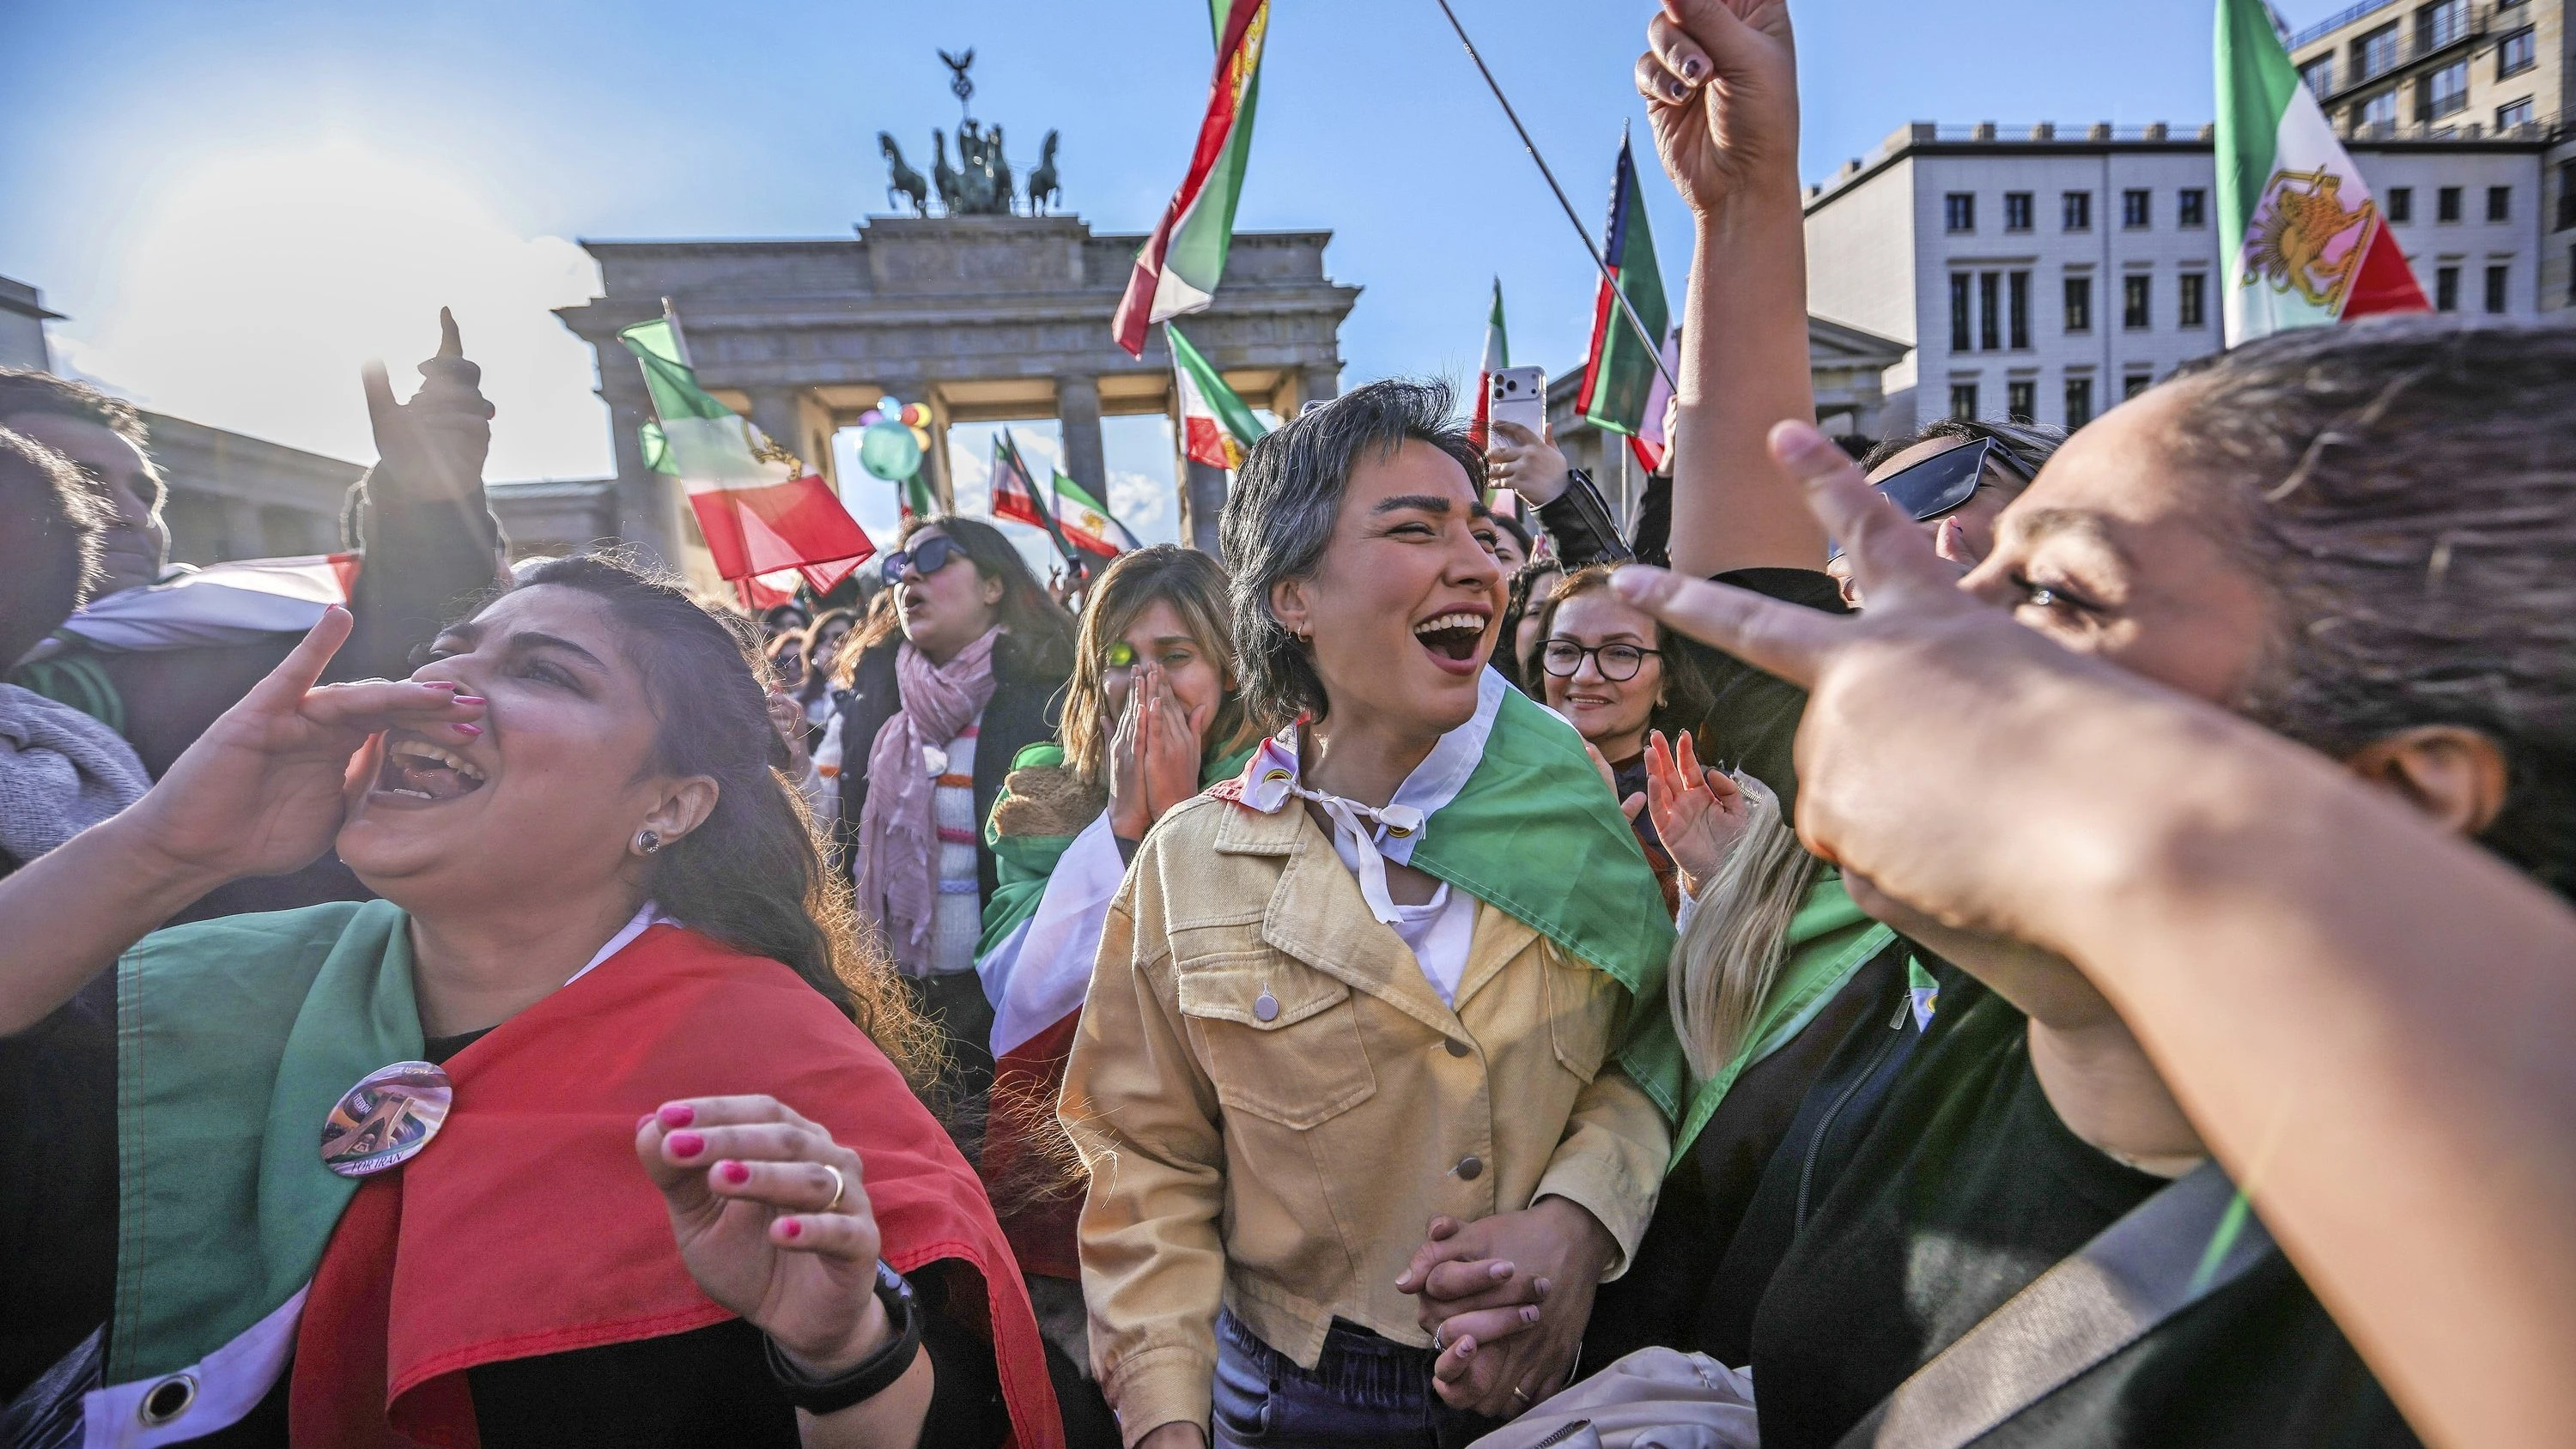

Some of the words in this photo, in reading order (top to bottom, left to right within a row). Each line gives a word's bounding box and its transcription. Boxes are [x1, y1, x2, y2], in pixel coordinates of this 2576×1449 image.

[353, 1093, 373, 1115] FREEDOM
[351, 1160, 374, 1173] FOR
[374, 1150, 404, 1168] IRAN
